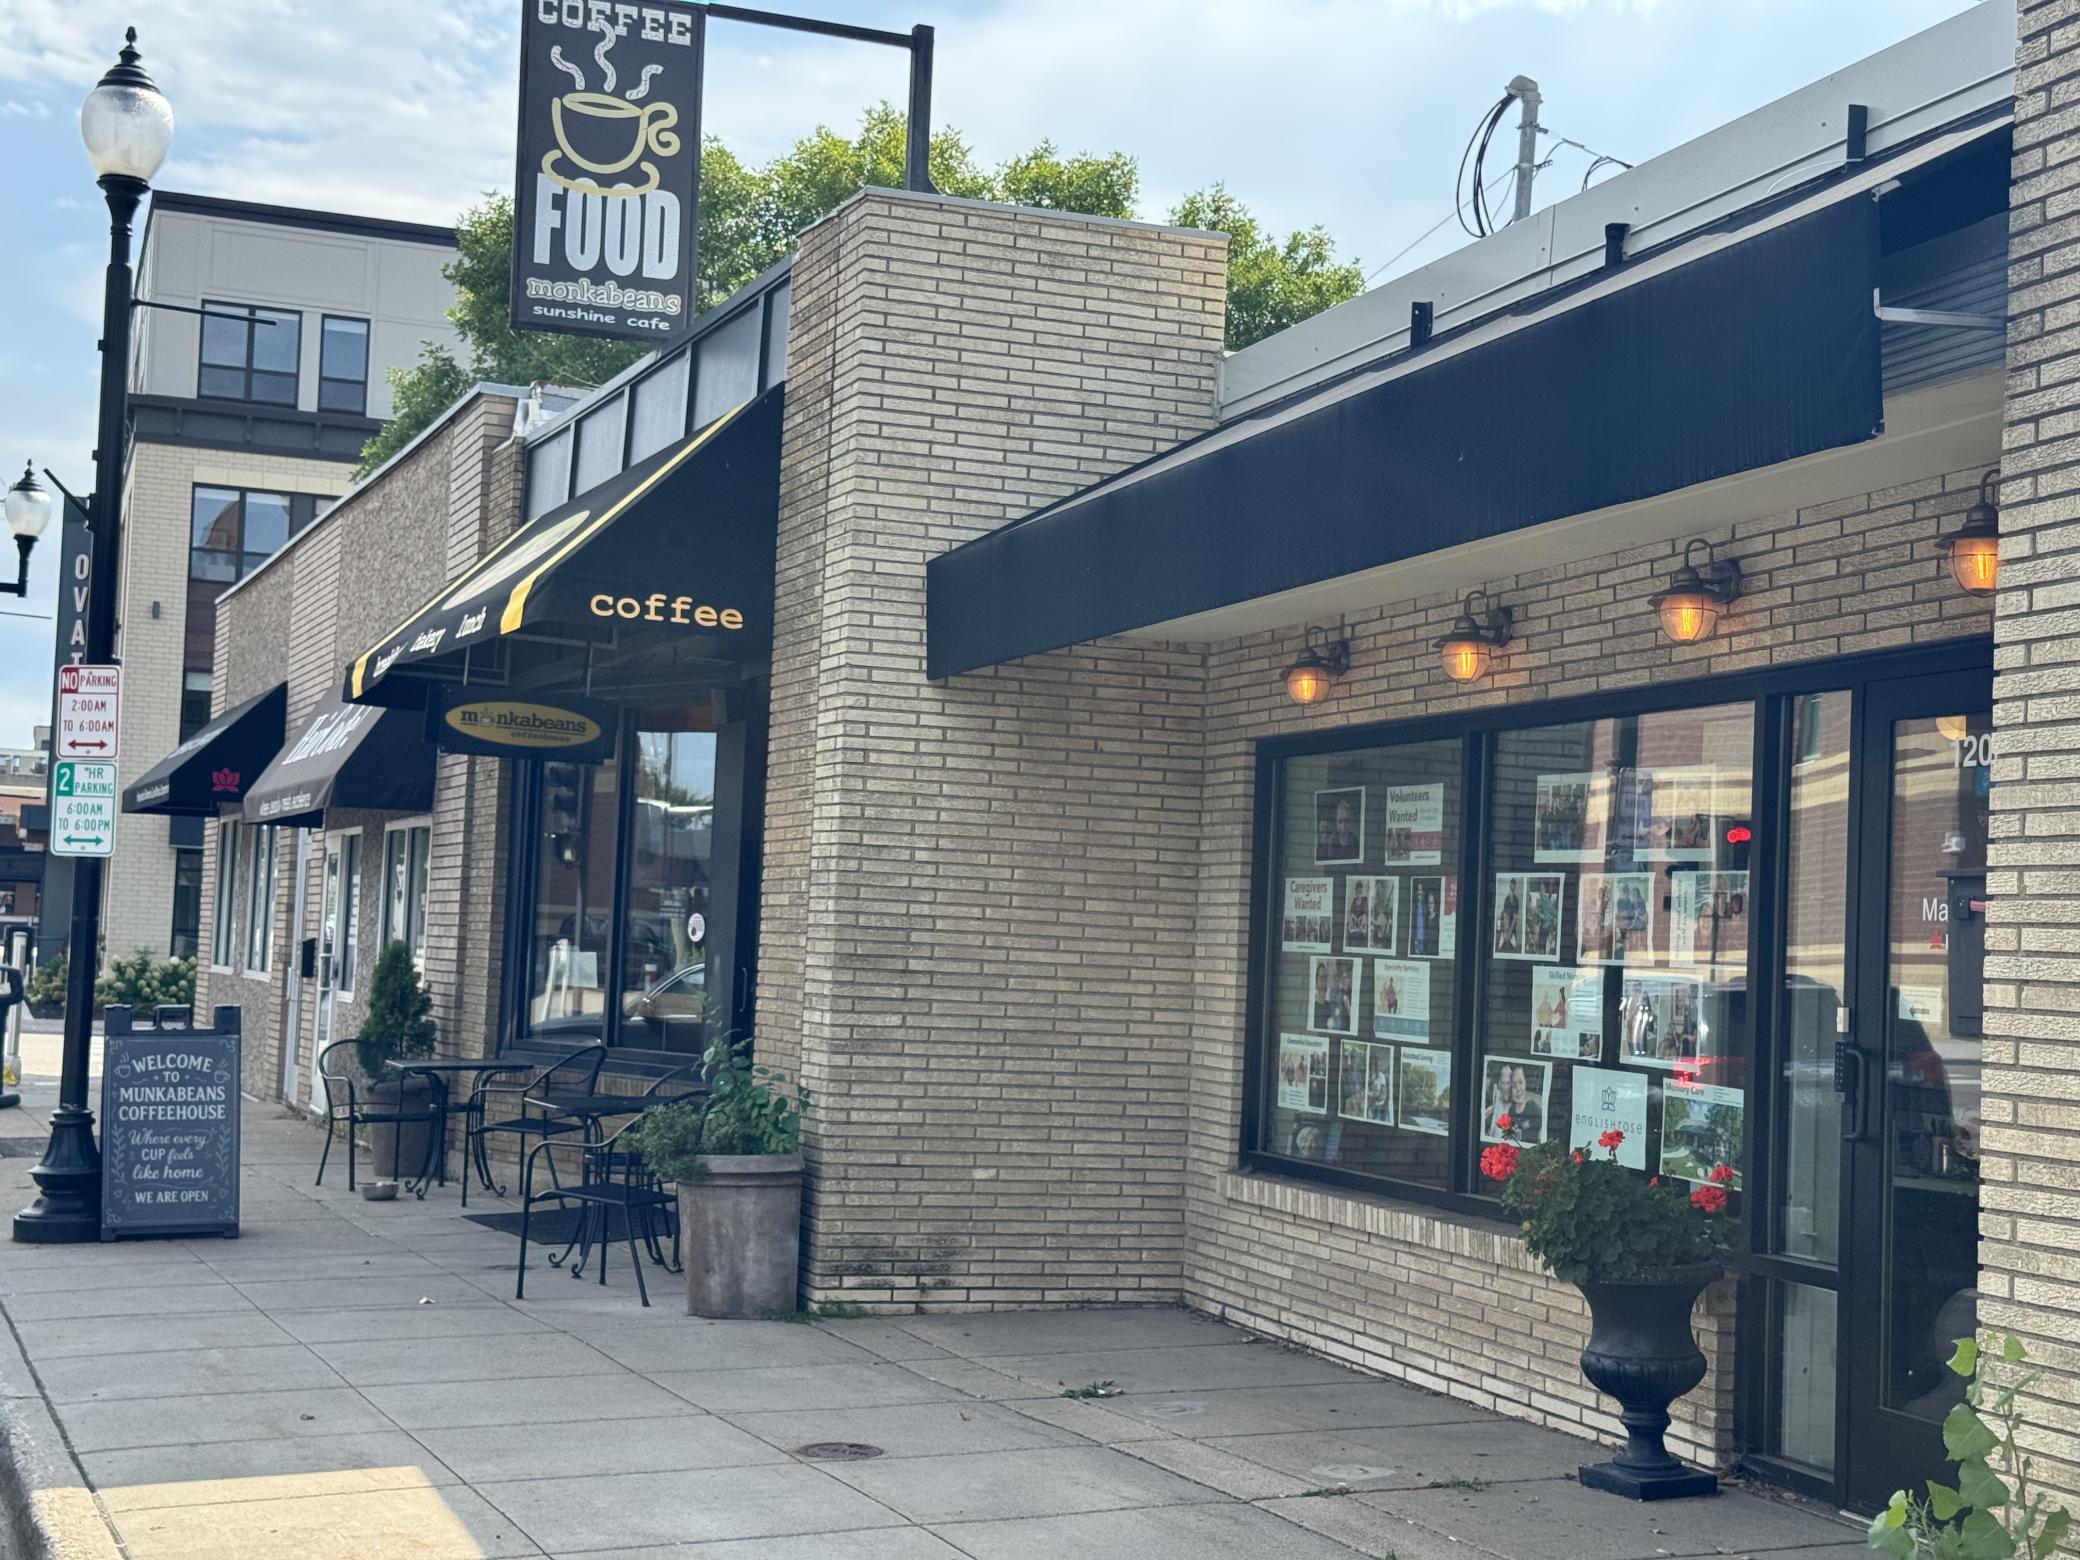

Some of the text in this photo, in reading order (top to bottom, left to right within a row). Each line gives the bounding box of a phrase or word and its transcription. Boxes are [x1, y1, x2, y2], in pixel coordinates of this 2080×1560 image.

[538, 0, 692, 46] COFFEE
[532, 173, 682, 281] FOOD
[526, 277, 682, 315] monkabeans
[533, 304, 671, 331] sunshine cafe
[590, 594, 744, 630] coffee
[62, 672, 117, 690] NO PARKING
[64, 719, 74, 732] TO
[58, 767, 104, 791] 2 HR
[75, 782, 113, 794] PARKING
[1389, 790, 1430, 803] Volunteers
[59, 817, 69, 830] TO
[1389, 809, 1418, 823] Wanted
[1290, 880, 1327, 896] Caregivers
[1294, 896, 1321, 910] Wanted
[132, 1053, 213, 1073] WELCOME
[163, 1071, 180, 1082] TO
[120, 1086, 226, 1103] MUNKABEANS
[119, 1105, 226, 1121] COFFEEHOUSE
[128, 1128, 208, 1150] Where every
[141, 1149, 195, 1164] CUP feels
[132, 1164, 204, 1180] like home
[135, 1190, 209, 1203] WE ARE OPEN
